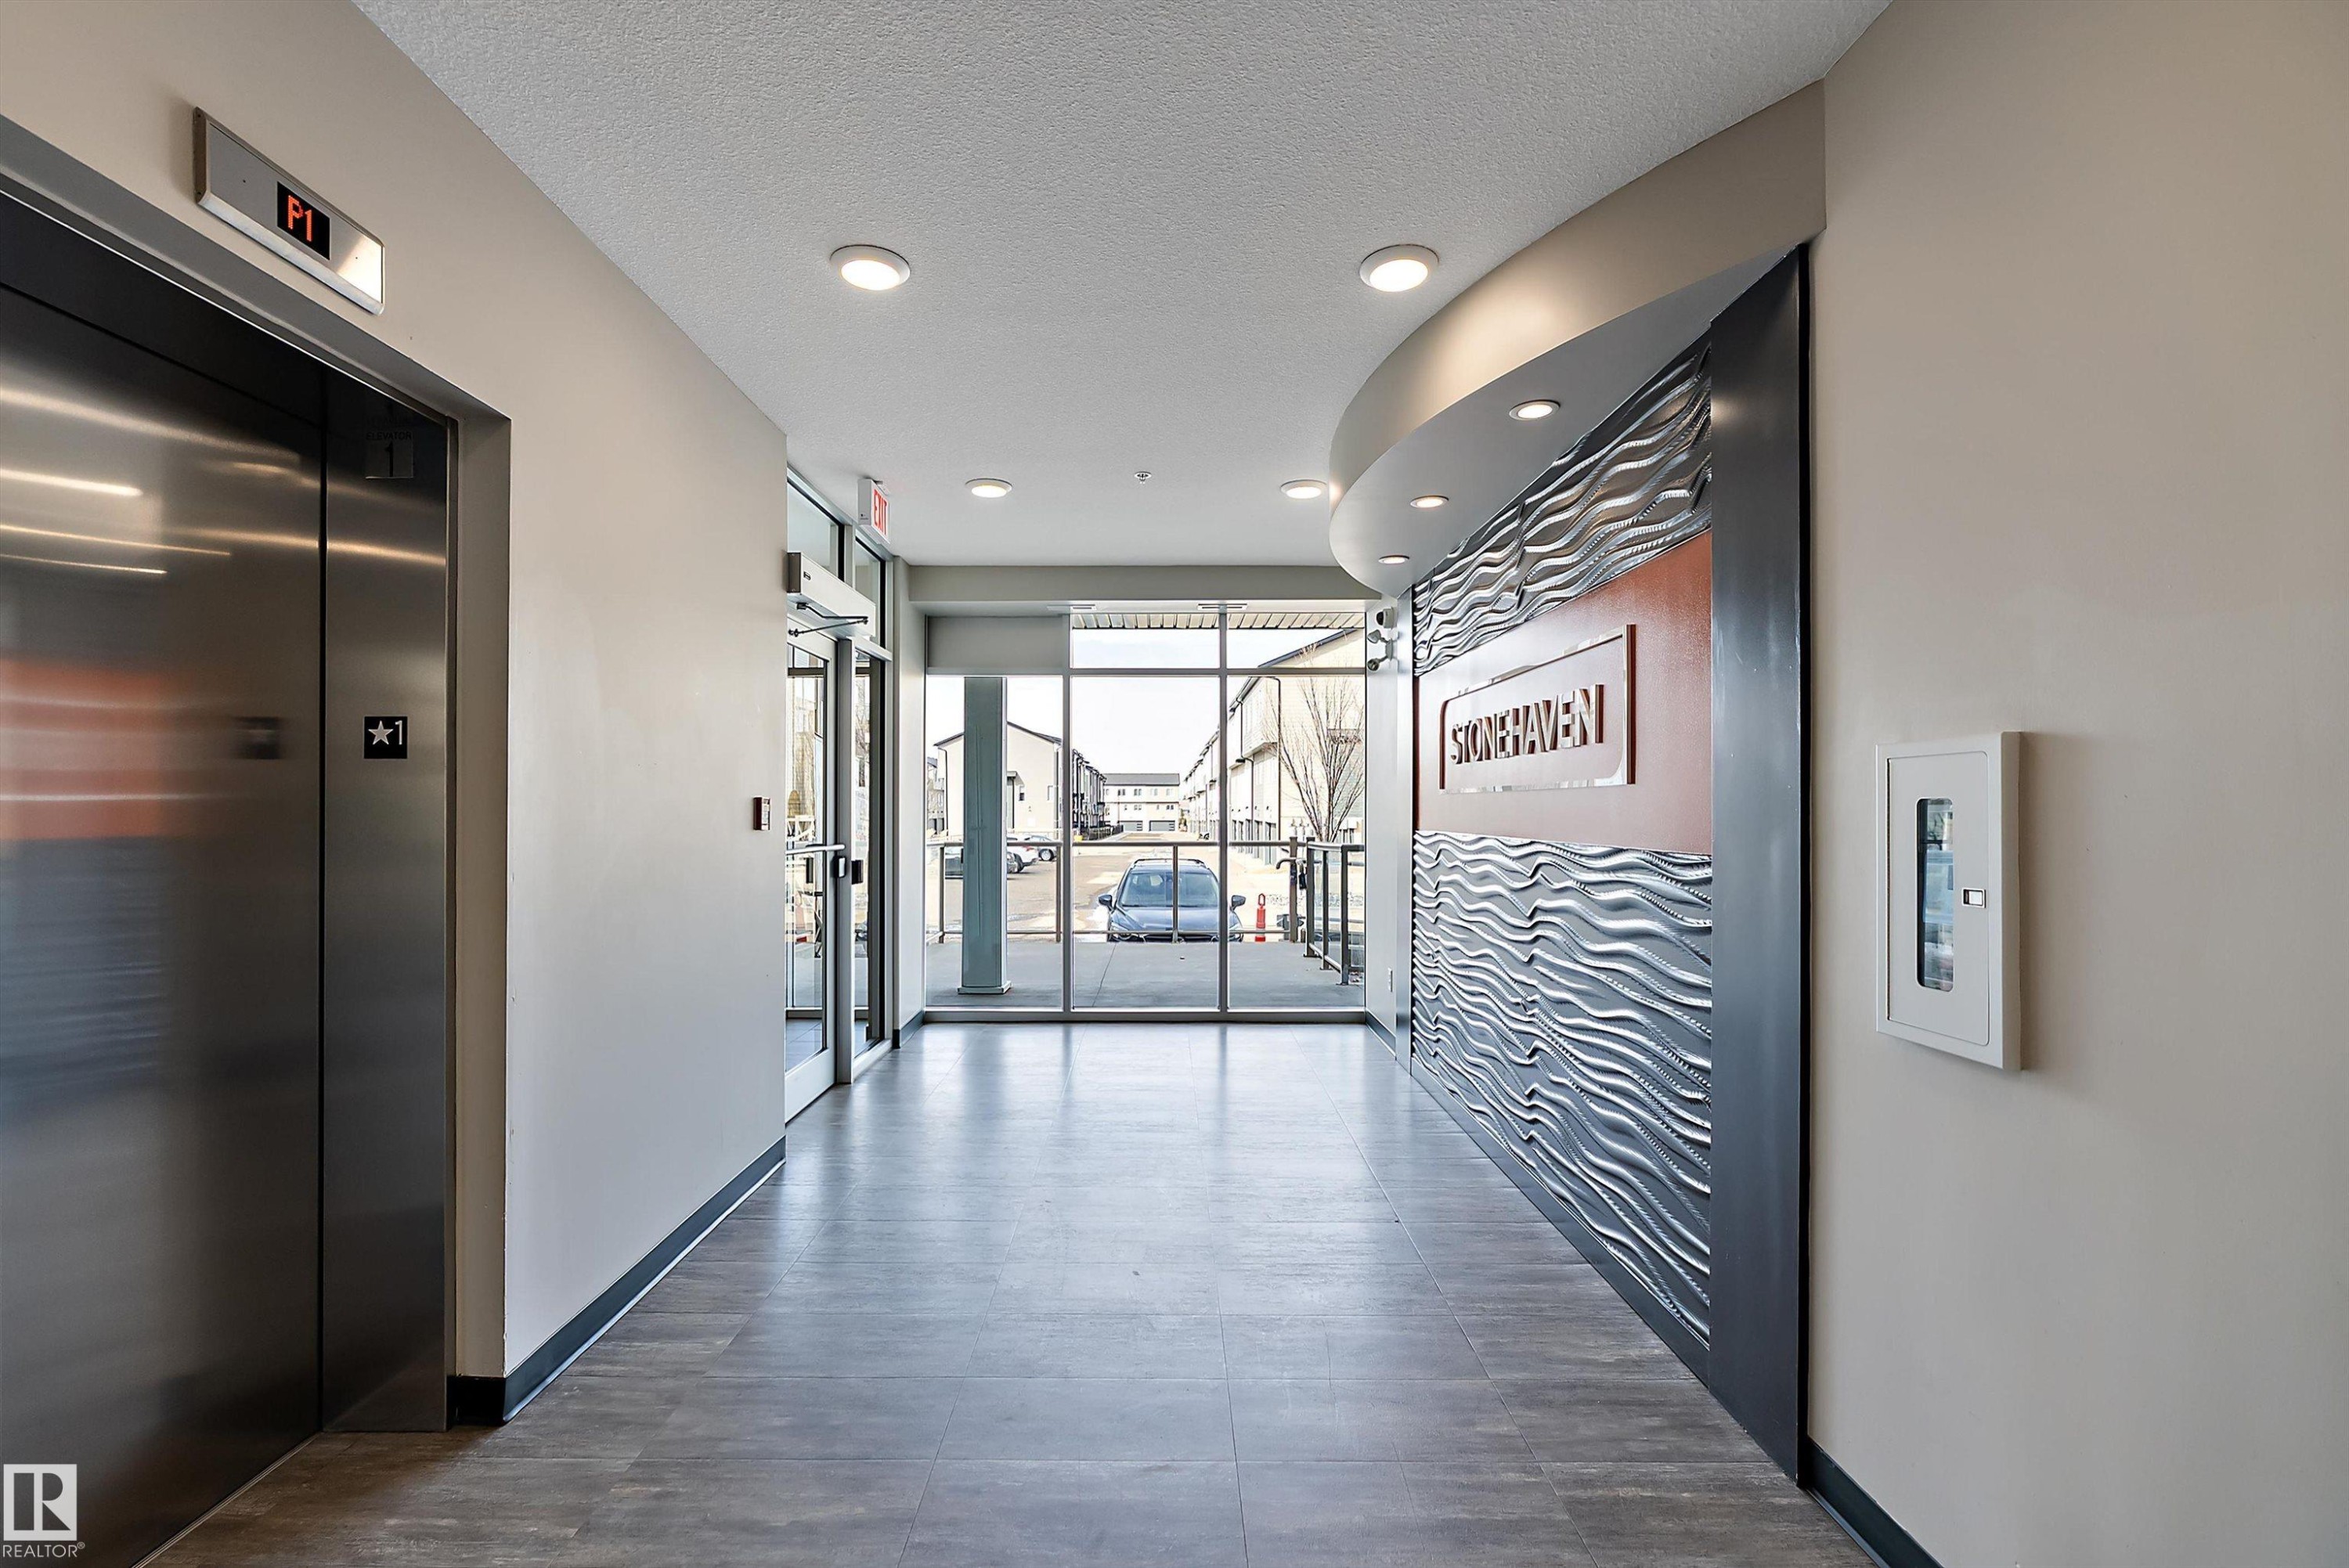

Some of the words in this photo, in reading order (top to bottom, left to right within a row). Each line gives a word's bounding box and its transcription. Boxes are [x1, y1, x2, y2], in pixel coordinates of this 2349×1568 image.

[287, 195, 313, 243] P1
[384, 441, 394, 478] 1
[874, 489, 887, 536] EXIT
[1451, 684, 1604, 765] STONEHAVEN
